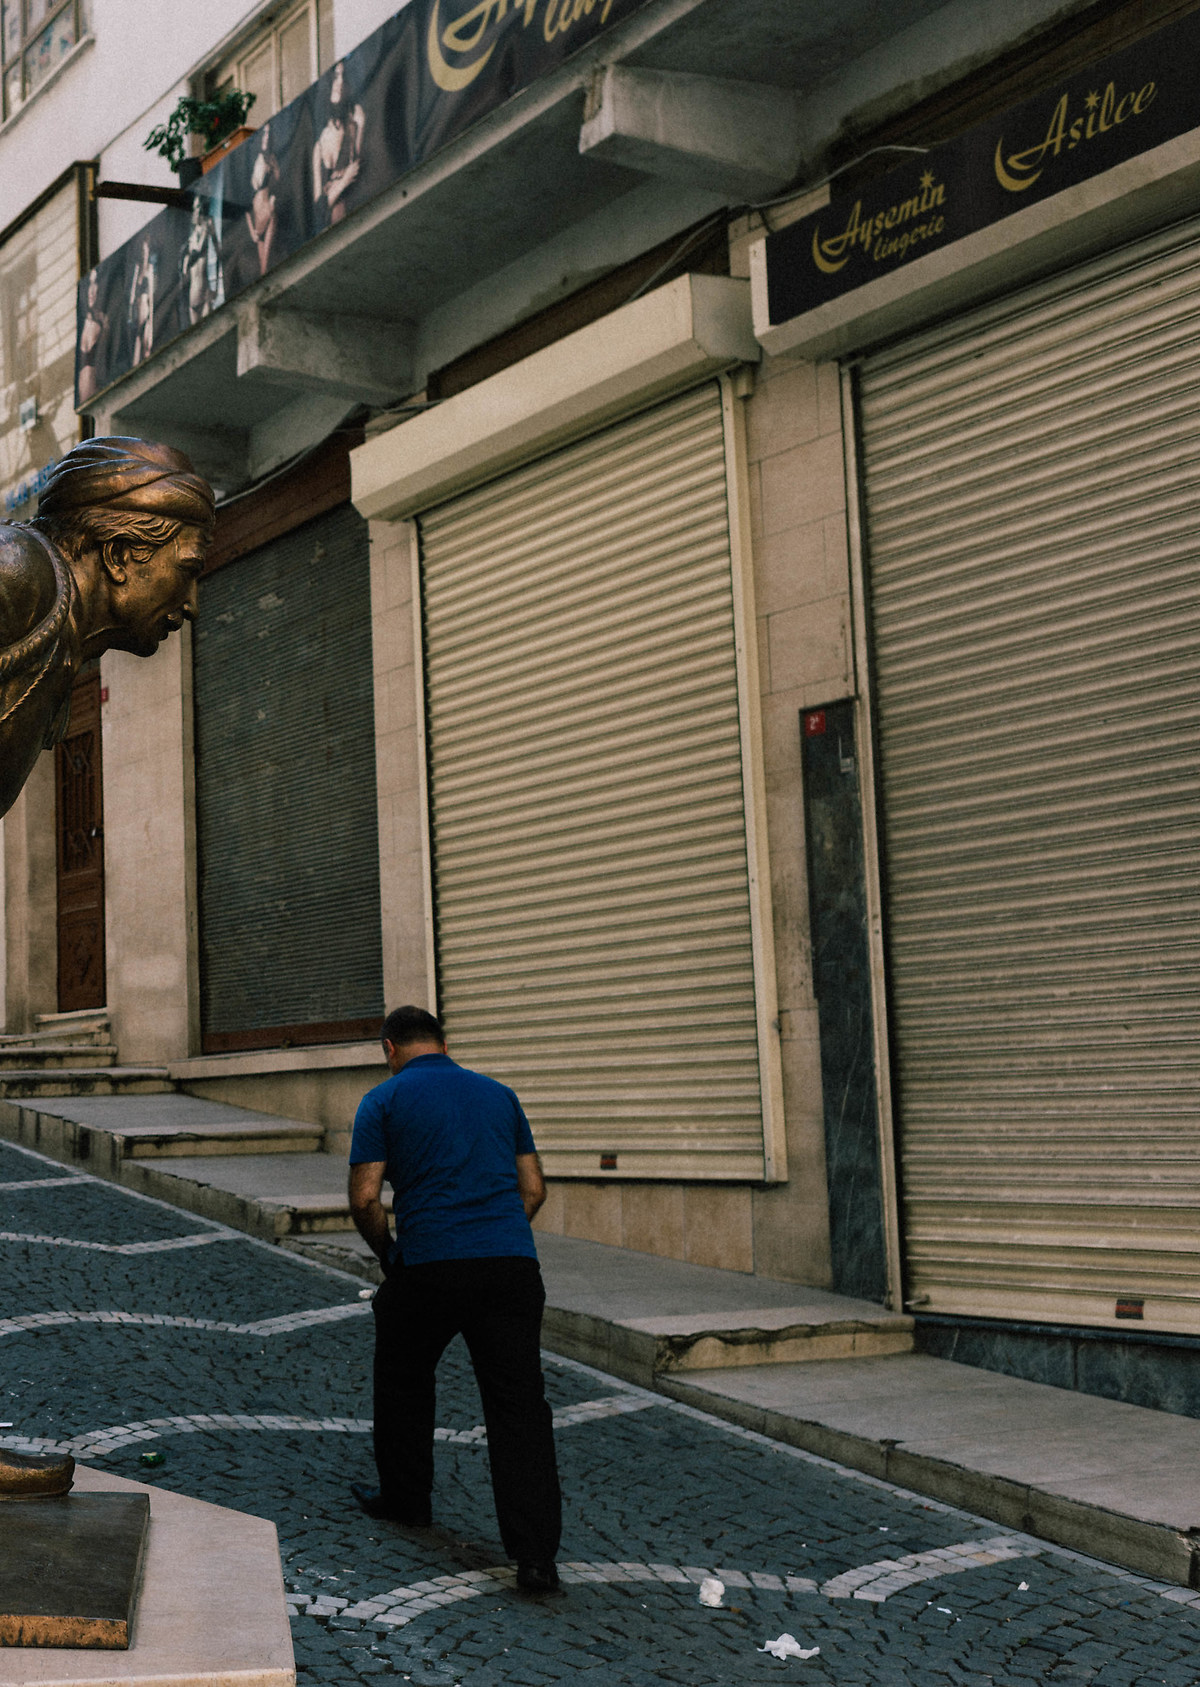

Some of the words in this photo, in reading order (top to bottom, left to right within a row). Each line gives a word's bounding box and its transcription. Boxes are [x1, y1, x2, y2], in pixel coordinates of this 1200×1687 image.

[1007, 81, 1158, 171] Asilce
[820, 170, 947, 257] Aysemin
[874, 215, 945, 261] lingerie
